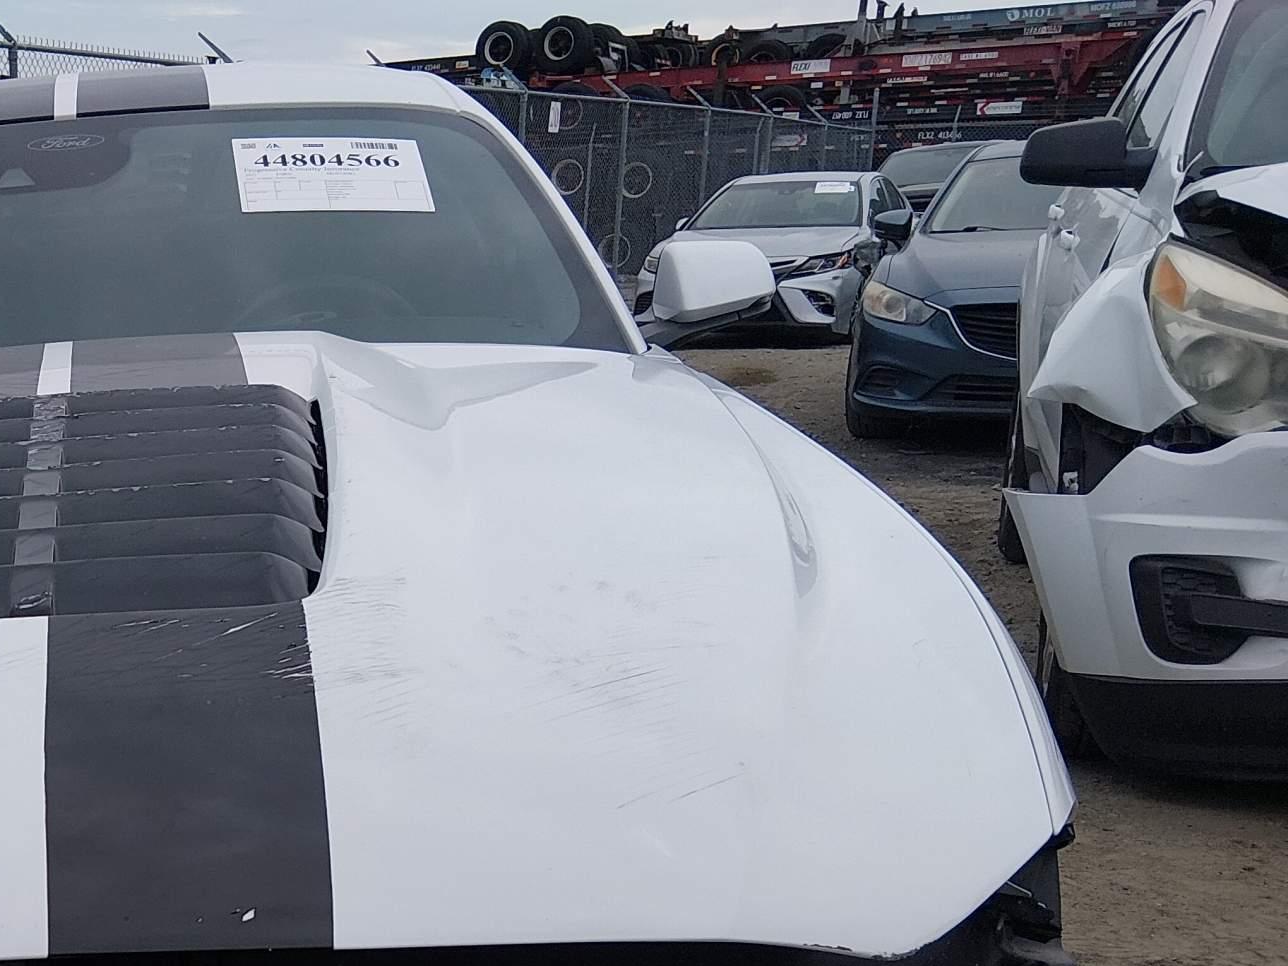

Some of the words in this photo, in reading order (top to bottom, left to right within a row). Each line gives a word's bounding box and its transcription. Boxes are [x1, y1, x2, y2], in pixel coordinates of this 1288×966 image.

[1022, 7, 1055, 18] MOL
[41, 136, 91, 149] Ford
[254, 152, 400, 168] 44804566
